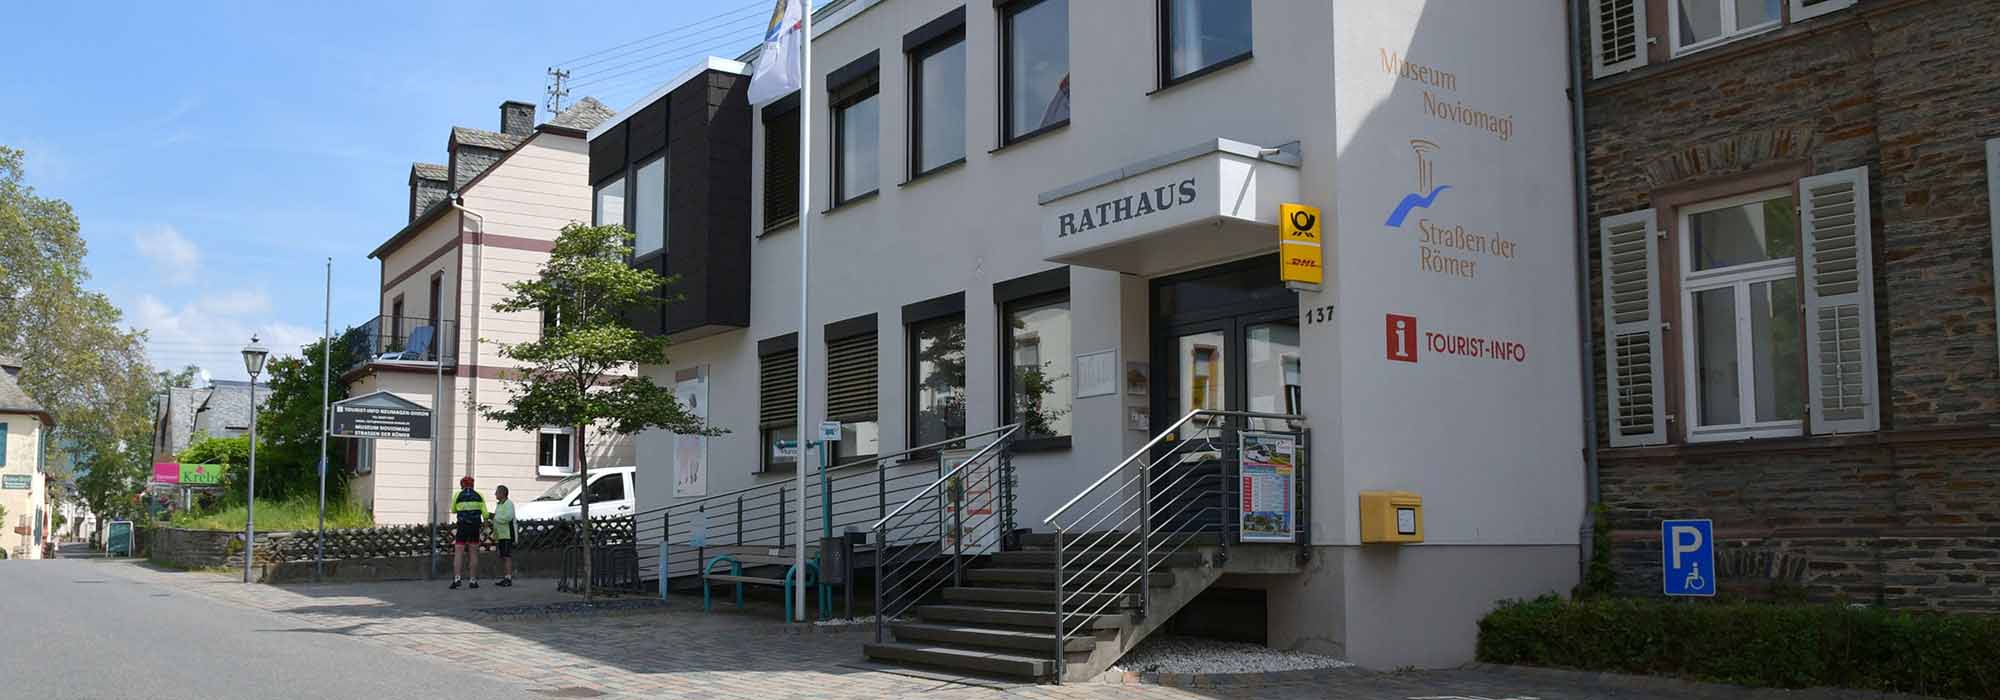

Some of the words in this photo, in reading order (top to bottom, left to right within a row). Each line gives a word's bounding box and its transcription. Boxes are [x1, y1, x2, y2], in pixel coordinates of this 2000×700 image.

[1379, 48, 1457, 91] Museum
[1423, 91, 1514, 142] Noviomagi
[1058, 178, 1197, 238] RATHAUS
[1419, 218, 1486, 254] Straßen
[1491, 232, 1517, 260] der
[1291, 258, 1317, 268] DHL
[1420, 246, 1477, 279] Römer
[1305, 305, 1334, 325] 137
[1425, 332, 1526, 362] TOURIST-INFO
[1672, 526, 1703, 569] P
